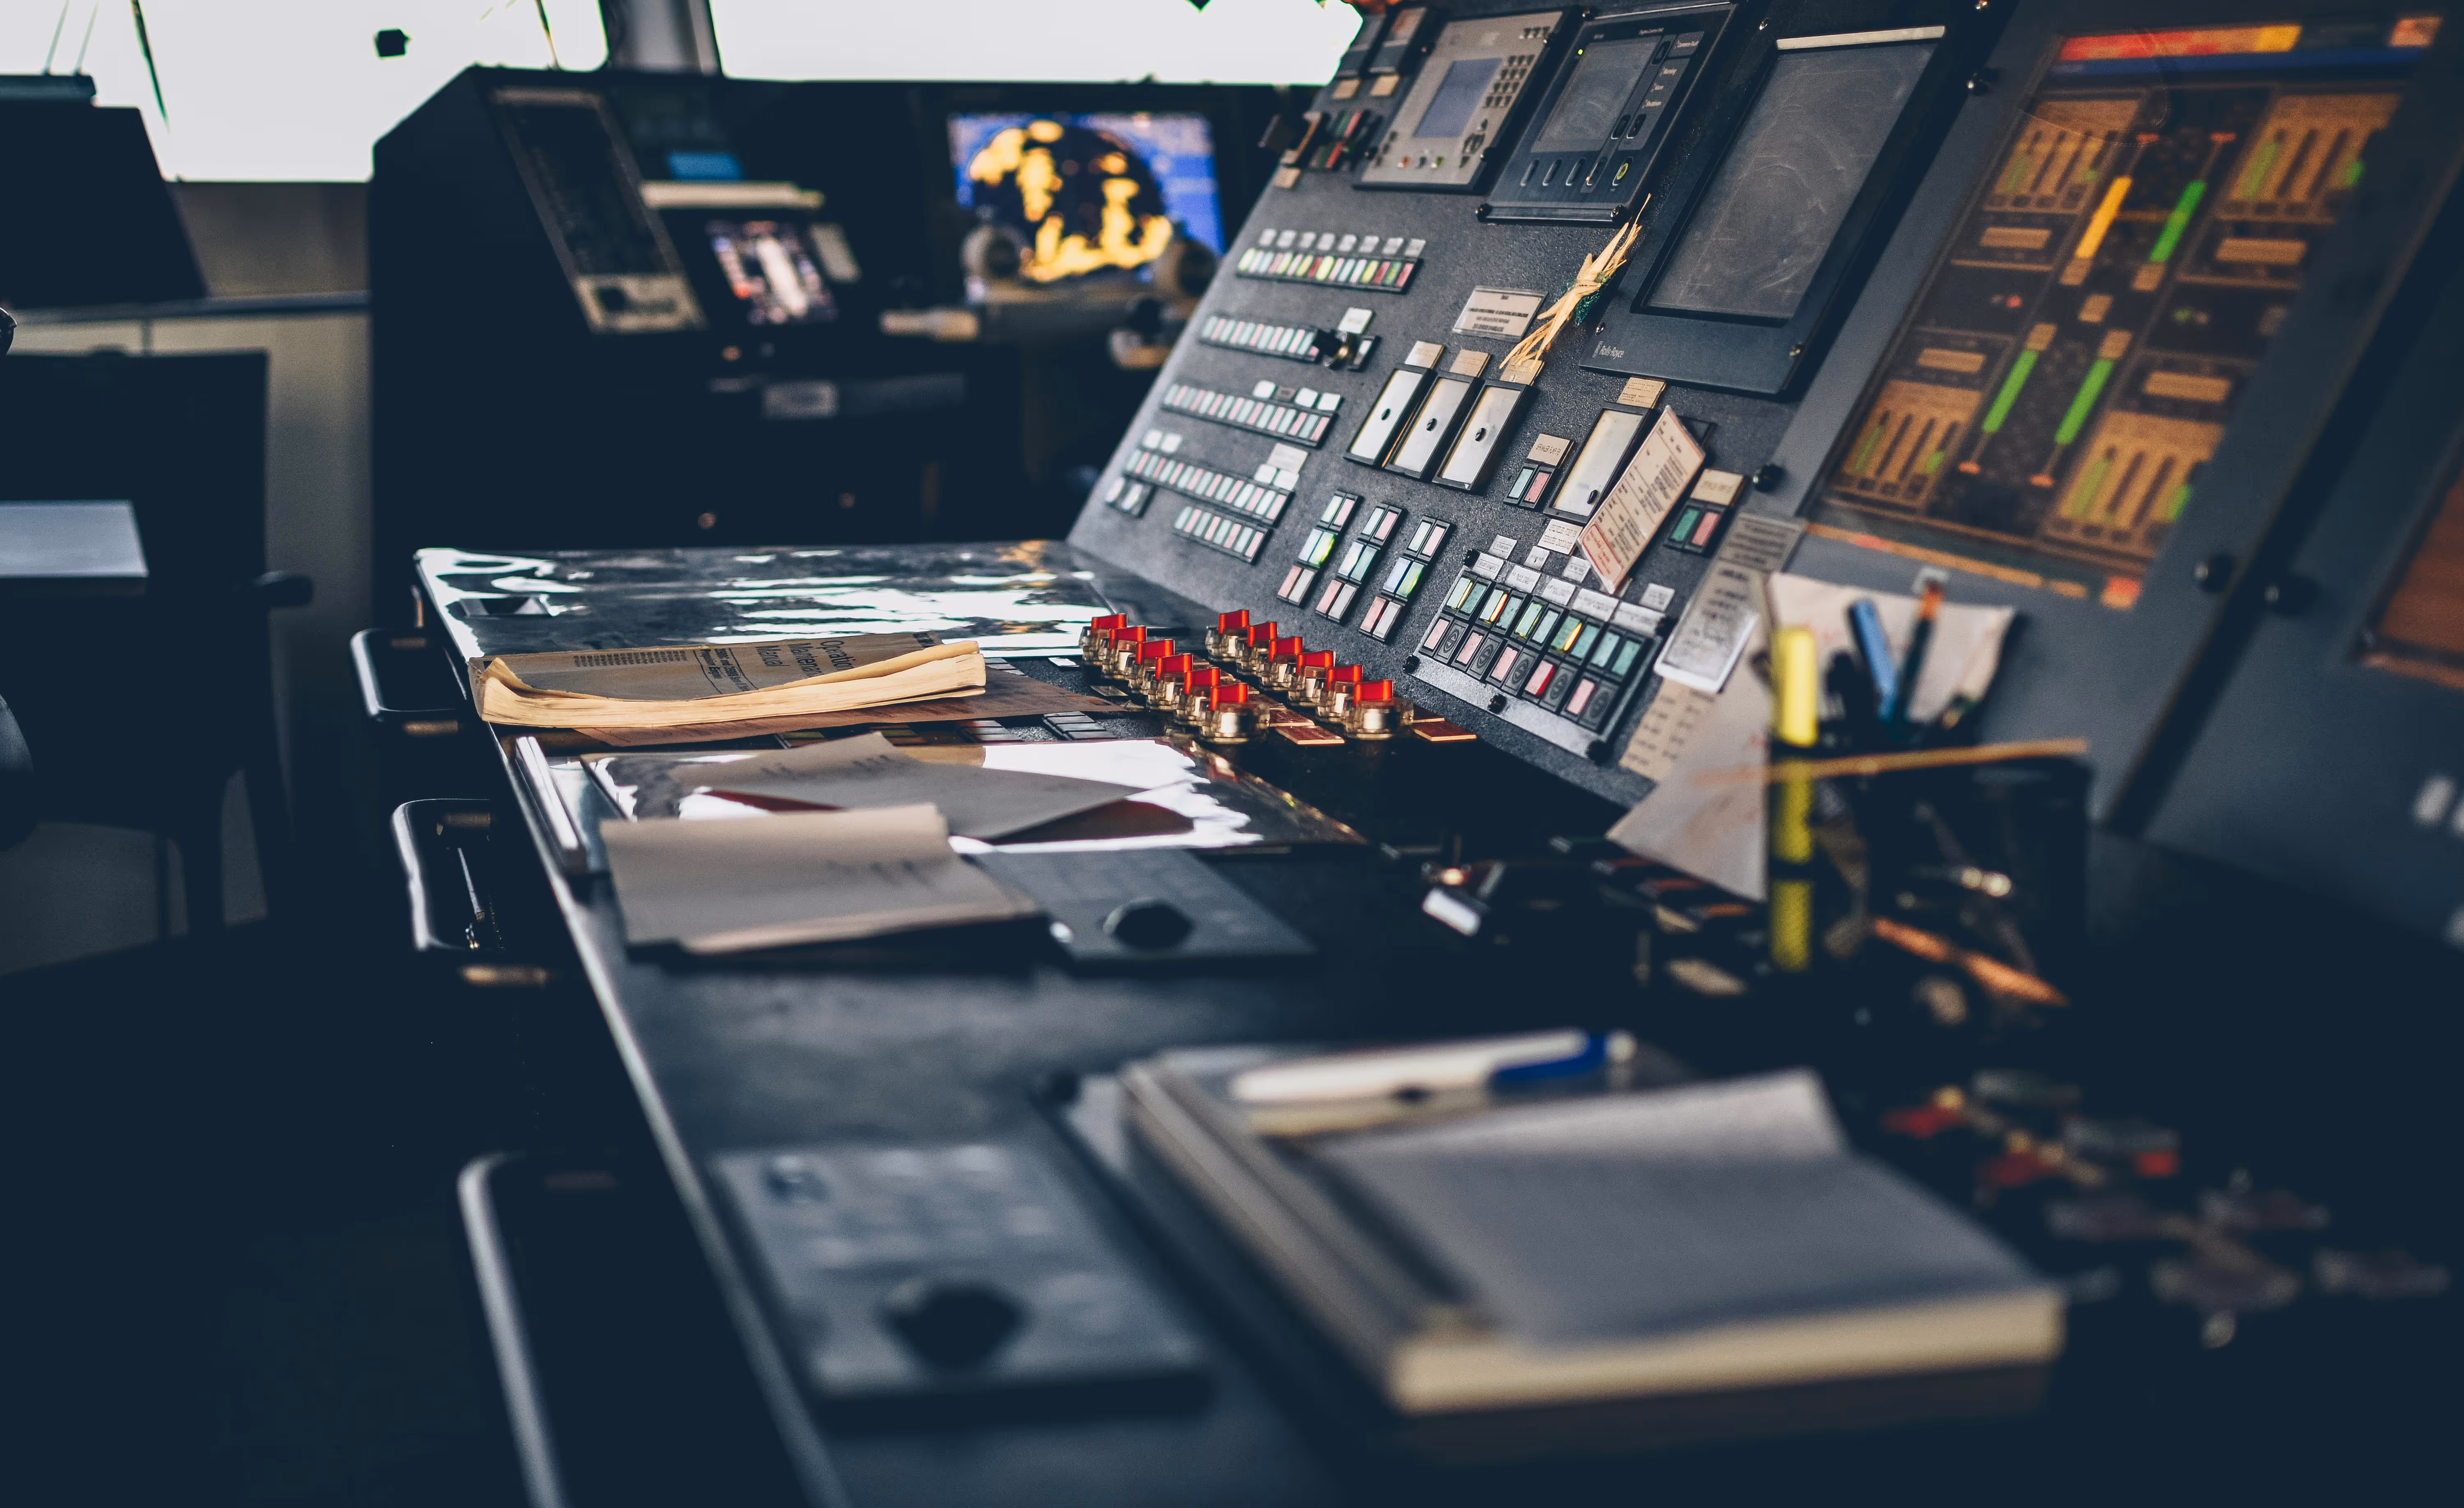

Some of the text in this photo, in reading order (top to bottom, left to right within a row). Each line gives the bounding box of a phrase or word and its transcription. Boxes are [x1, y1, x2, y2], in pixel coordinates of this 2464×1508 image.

[756, 645, 790, 666] Manual
[788, 643, 823, 677] Maintenan
[816, 640, 856, 671] Operation
